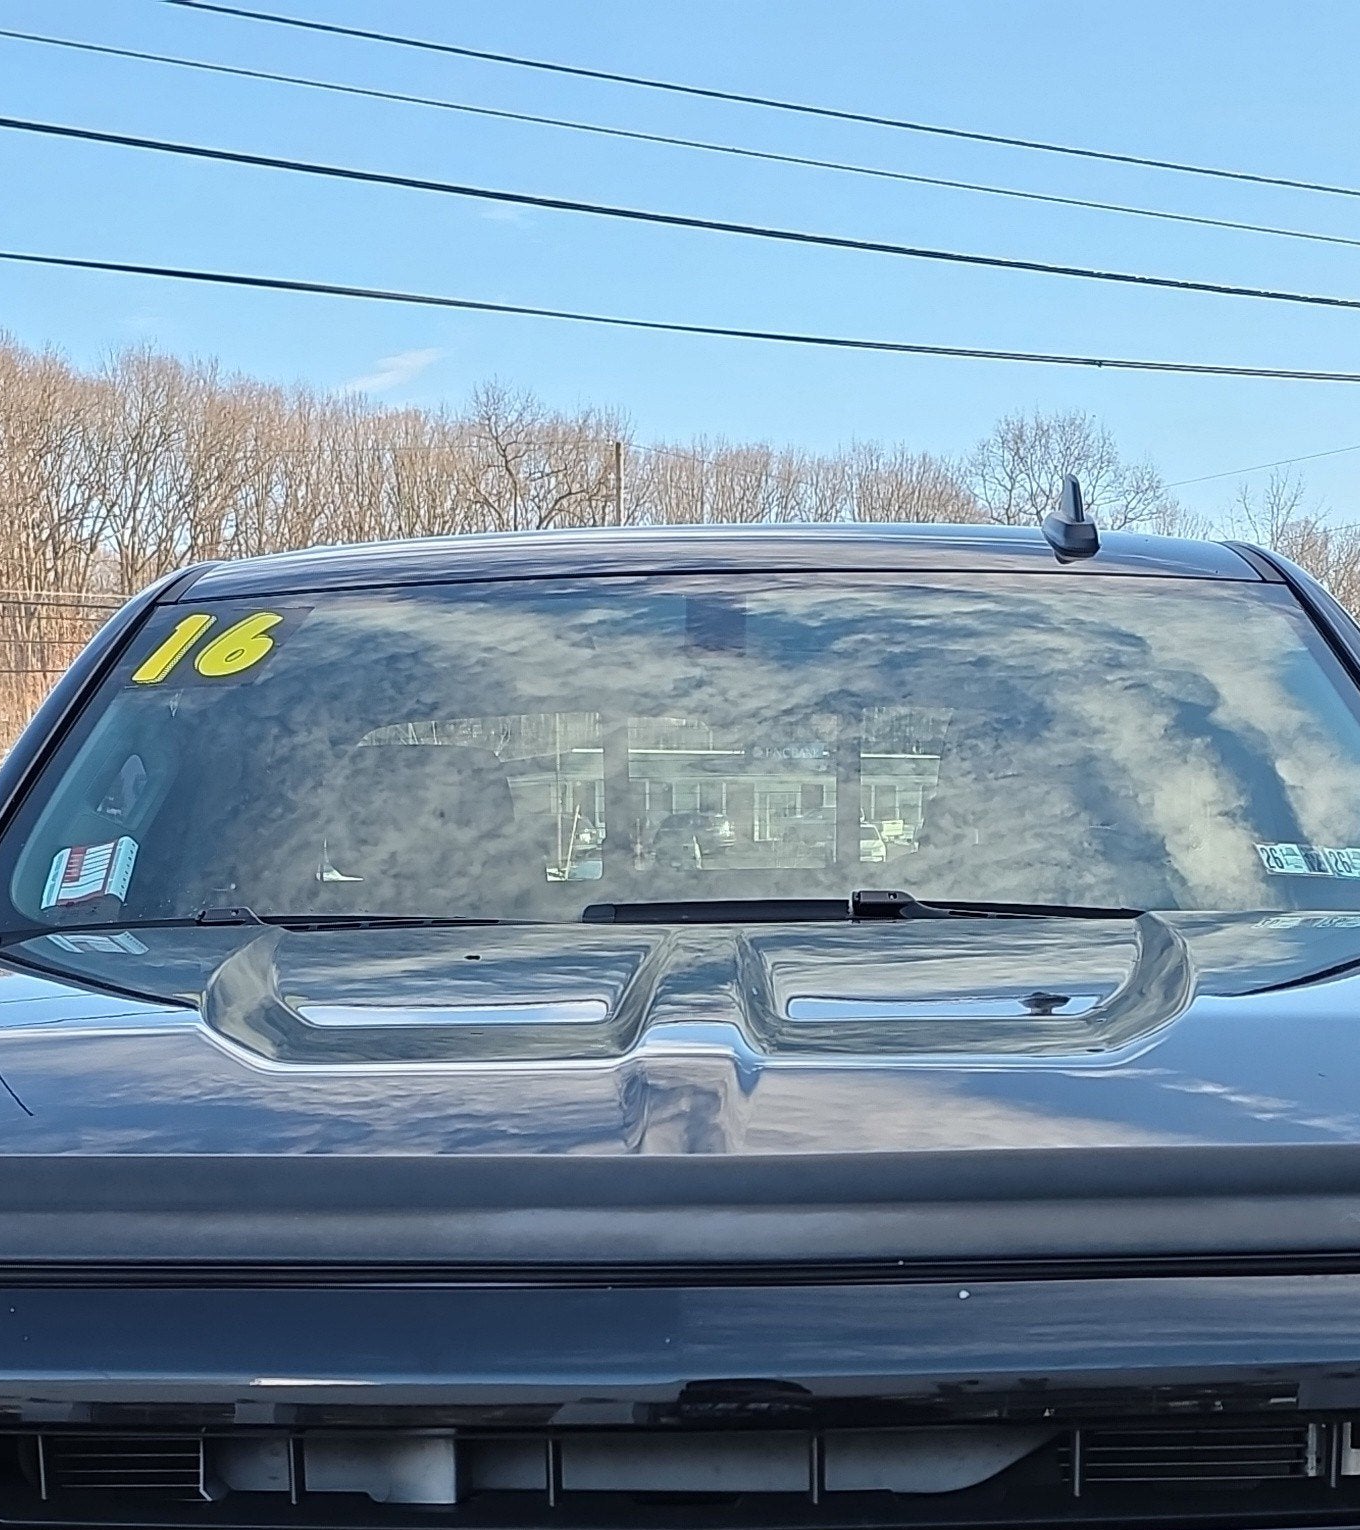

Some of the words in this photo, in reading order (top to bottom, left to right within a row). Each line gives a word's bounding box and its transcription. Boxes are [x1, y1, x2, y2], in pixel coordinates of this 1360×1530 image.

[132, 612, 283, 685] 16
[1261, 847, 1285, 870] 26
[1328, 850, 1353, 874] 26
